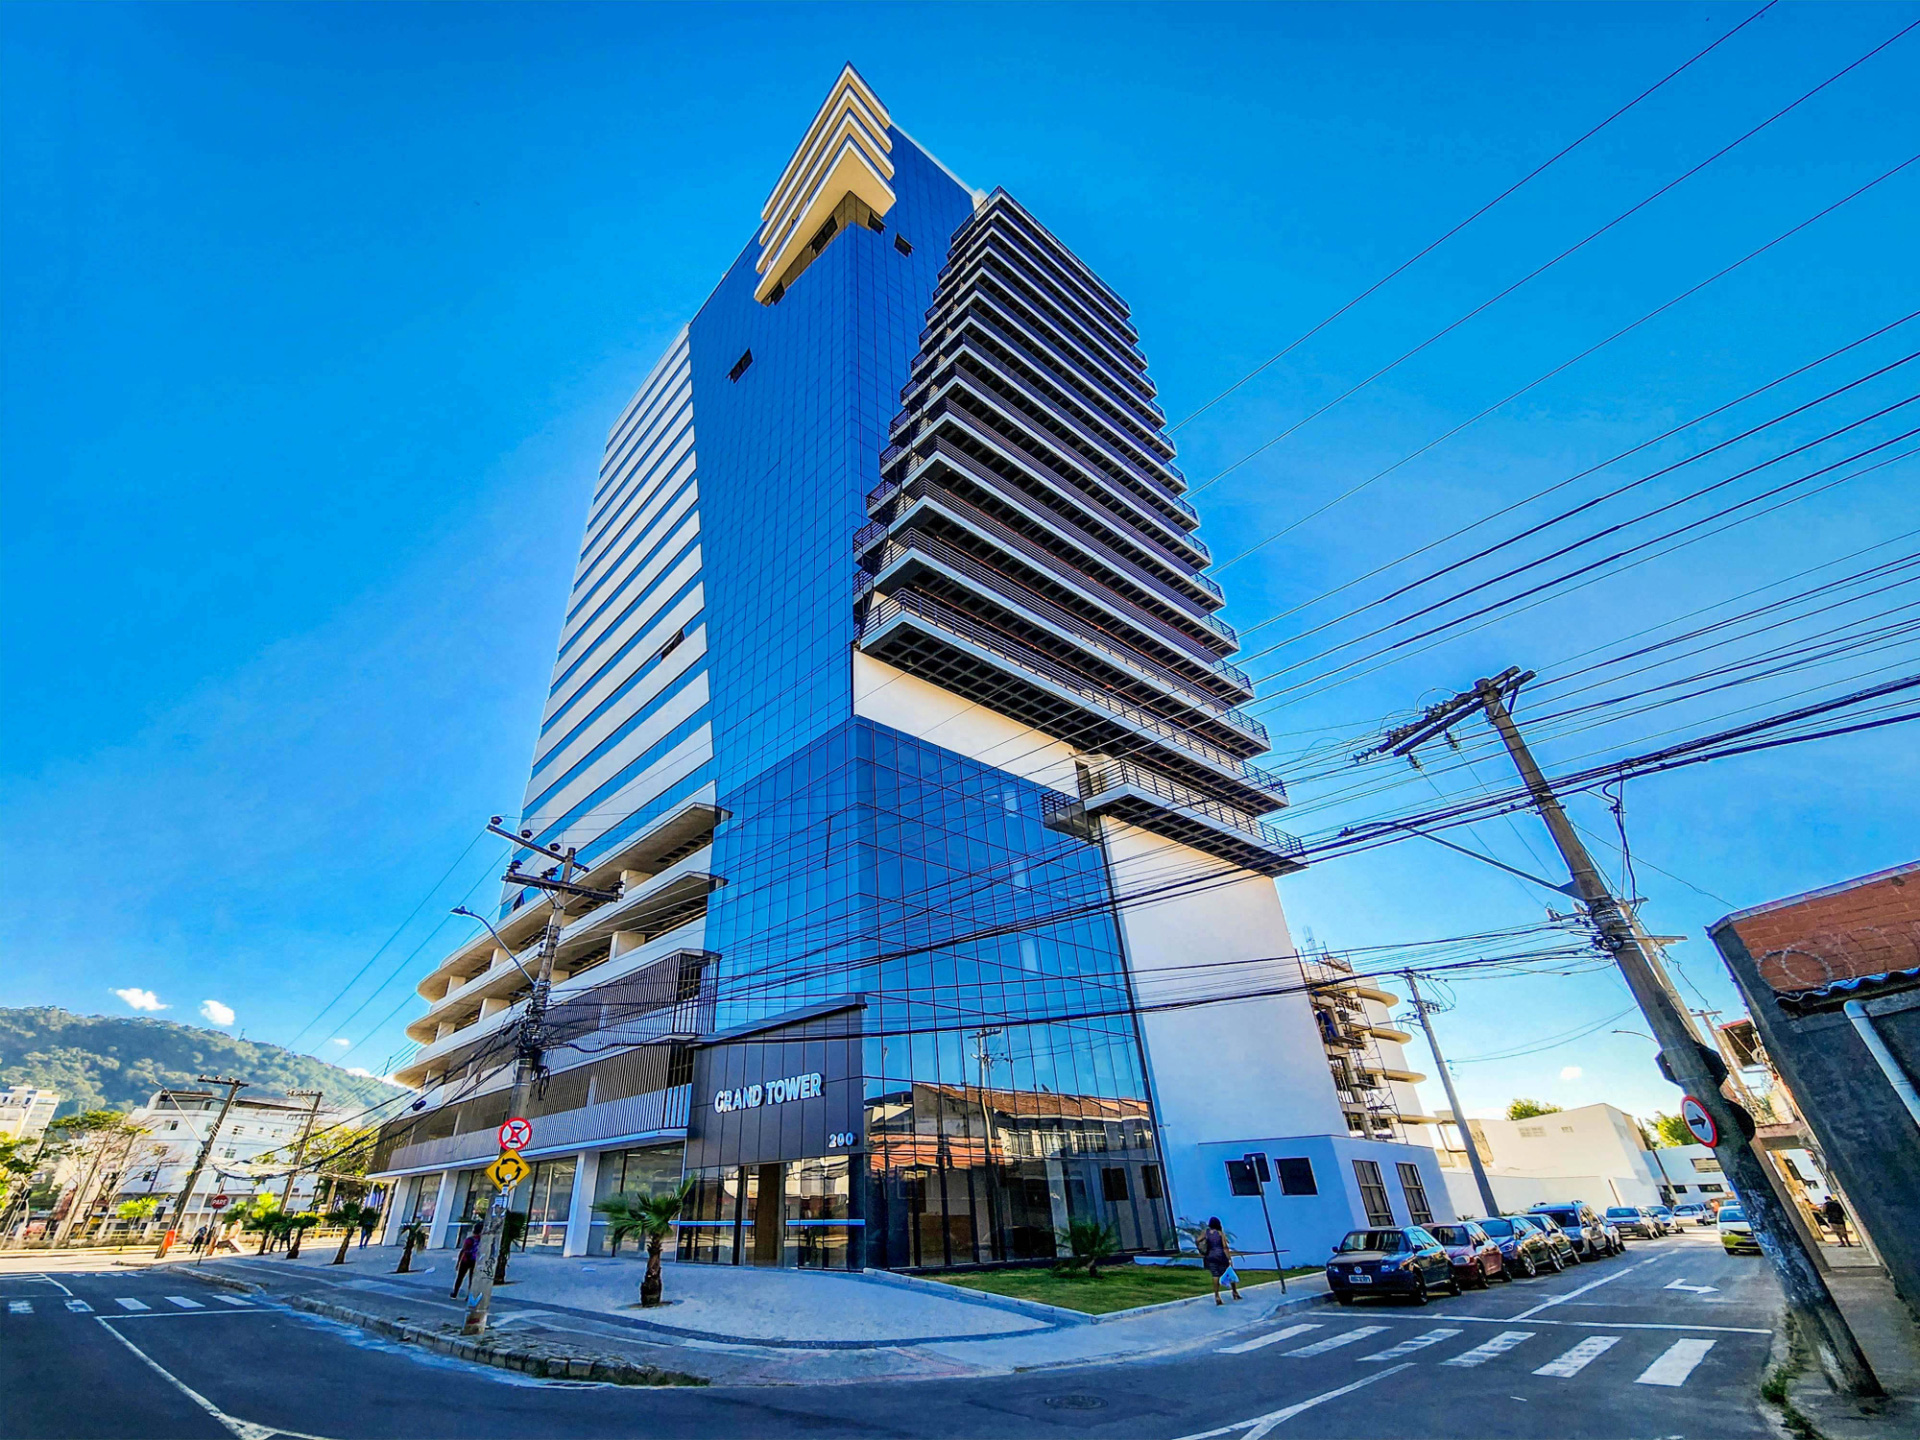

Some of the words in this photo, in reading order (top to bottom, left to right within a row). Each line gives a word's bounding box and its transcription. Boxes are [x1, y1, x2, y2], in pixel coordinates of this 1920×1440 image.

[714, 1084, 763, 1113] GRAND
[765, 1072, 822, 1105] TOWER
[828, 1132, 854, 1148] 200
